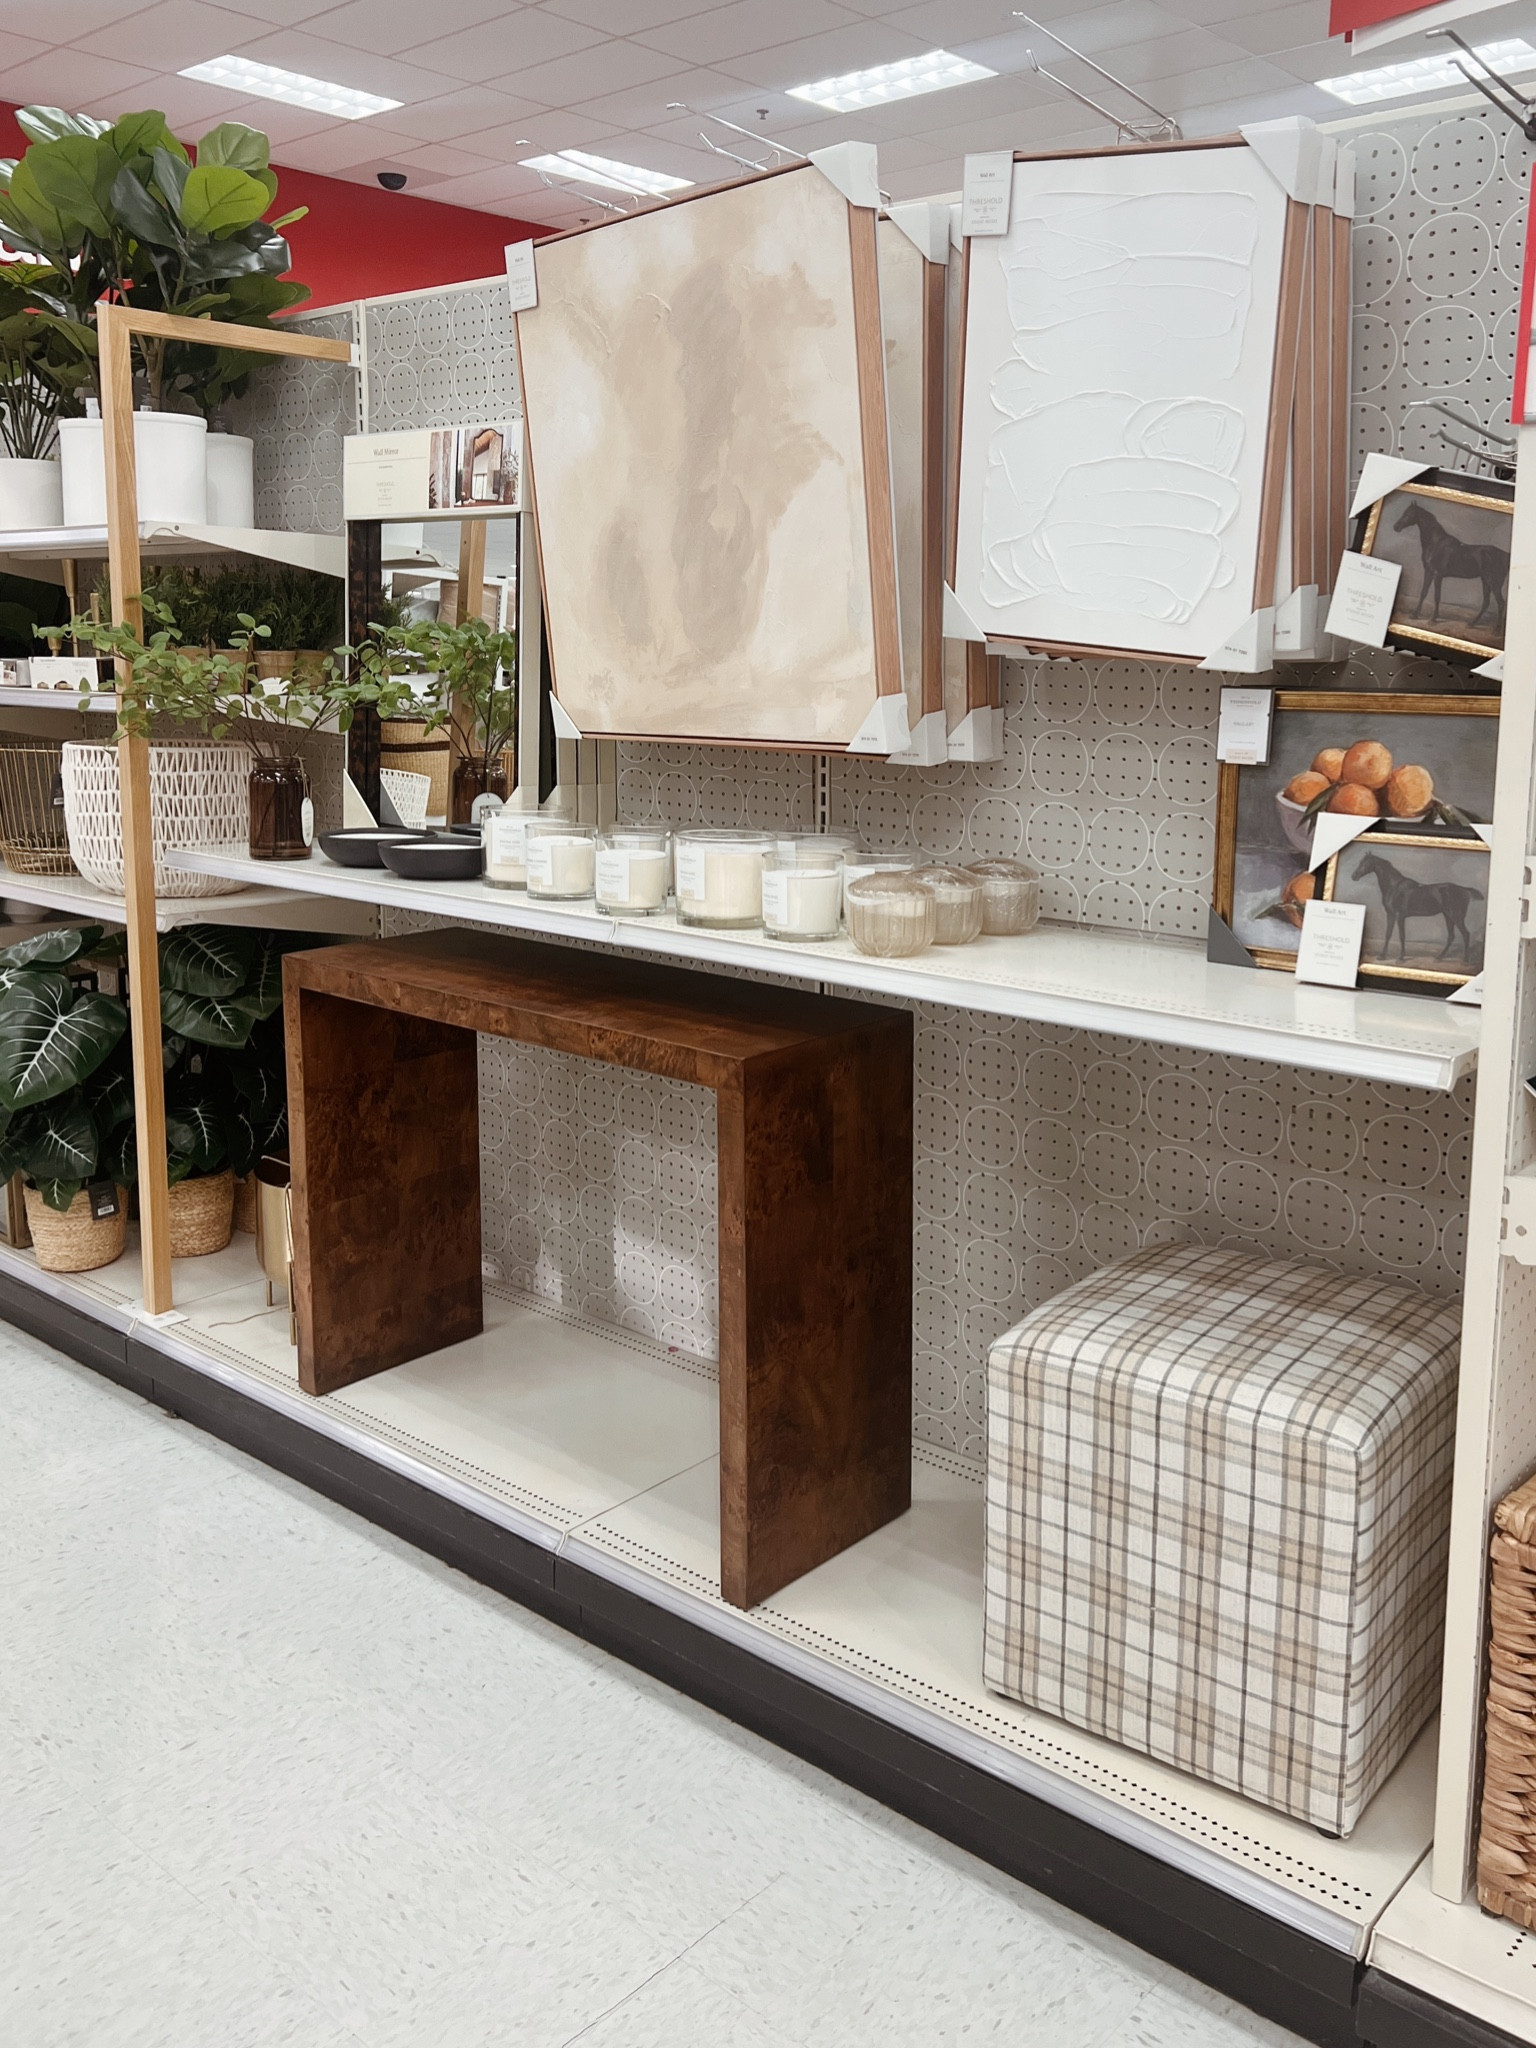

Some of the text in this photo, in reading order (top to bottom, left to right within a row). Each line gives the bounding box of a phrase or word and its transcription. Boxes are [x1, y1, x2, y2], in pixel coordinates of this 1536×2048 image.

[373, 447, 399, 457] Wall Mirror
[1360, 561, 1383, 573] Wall Art
